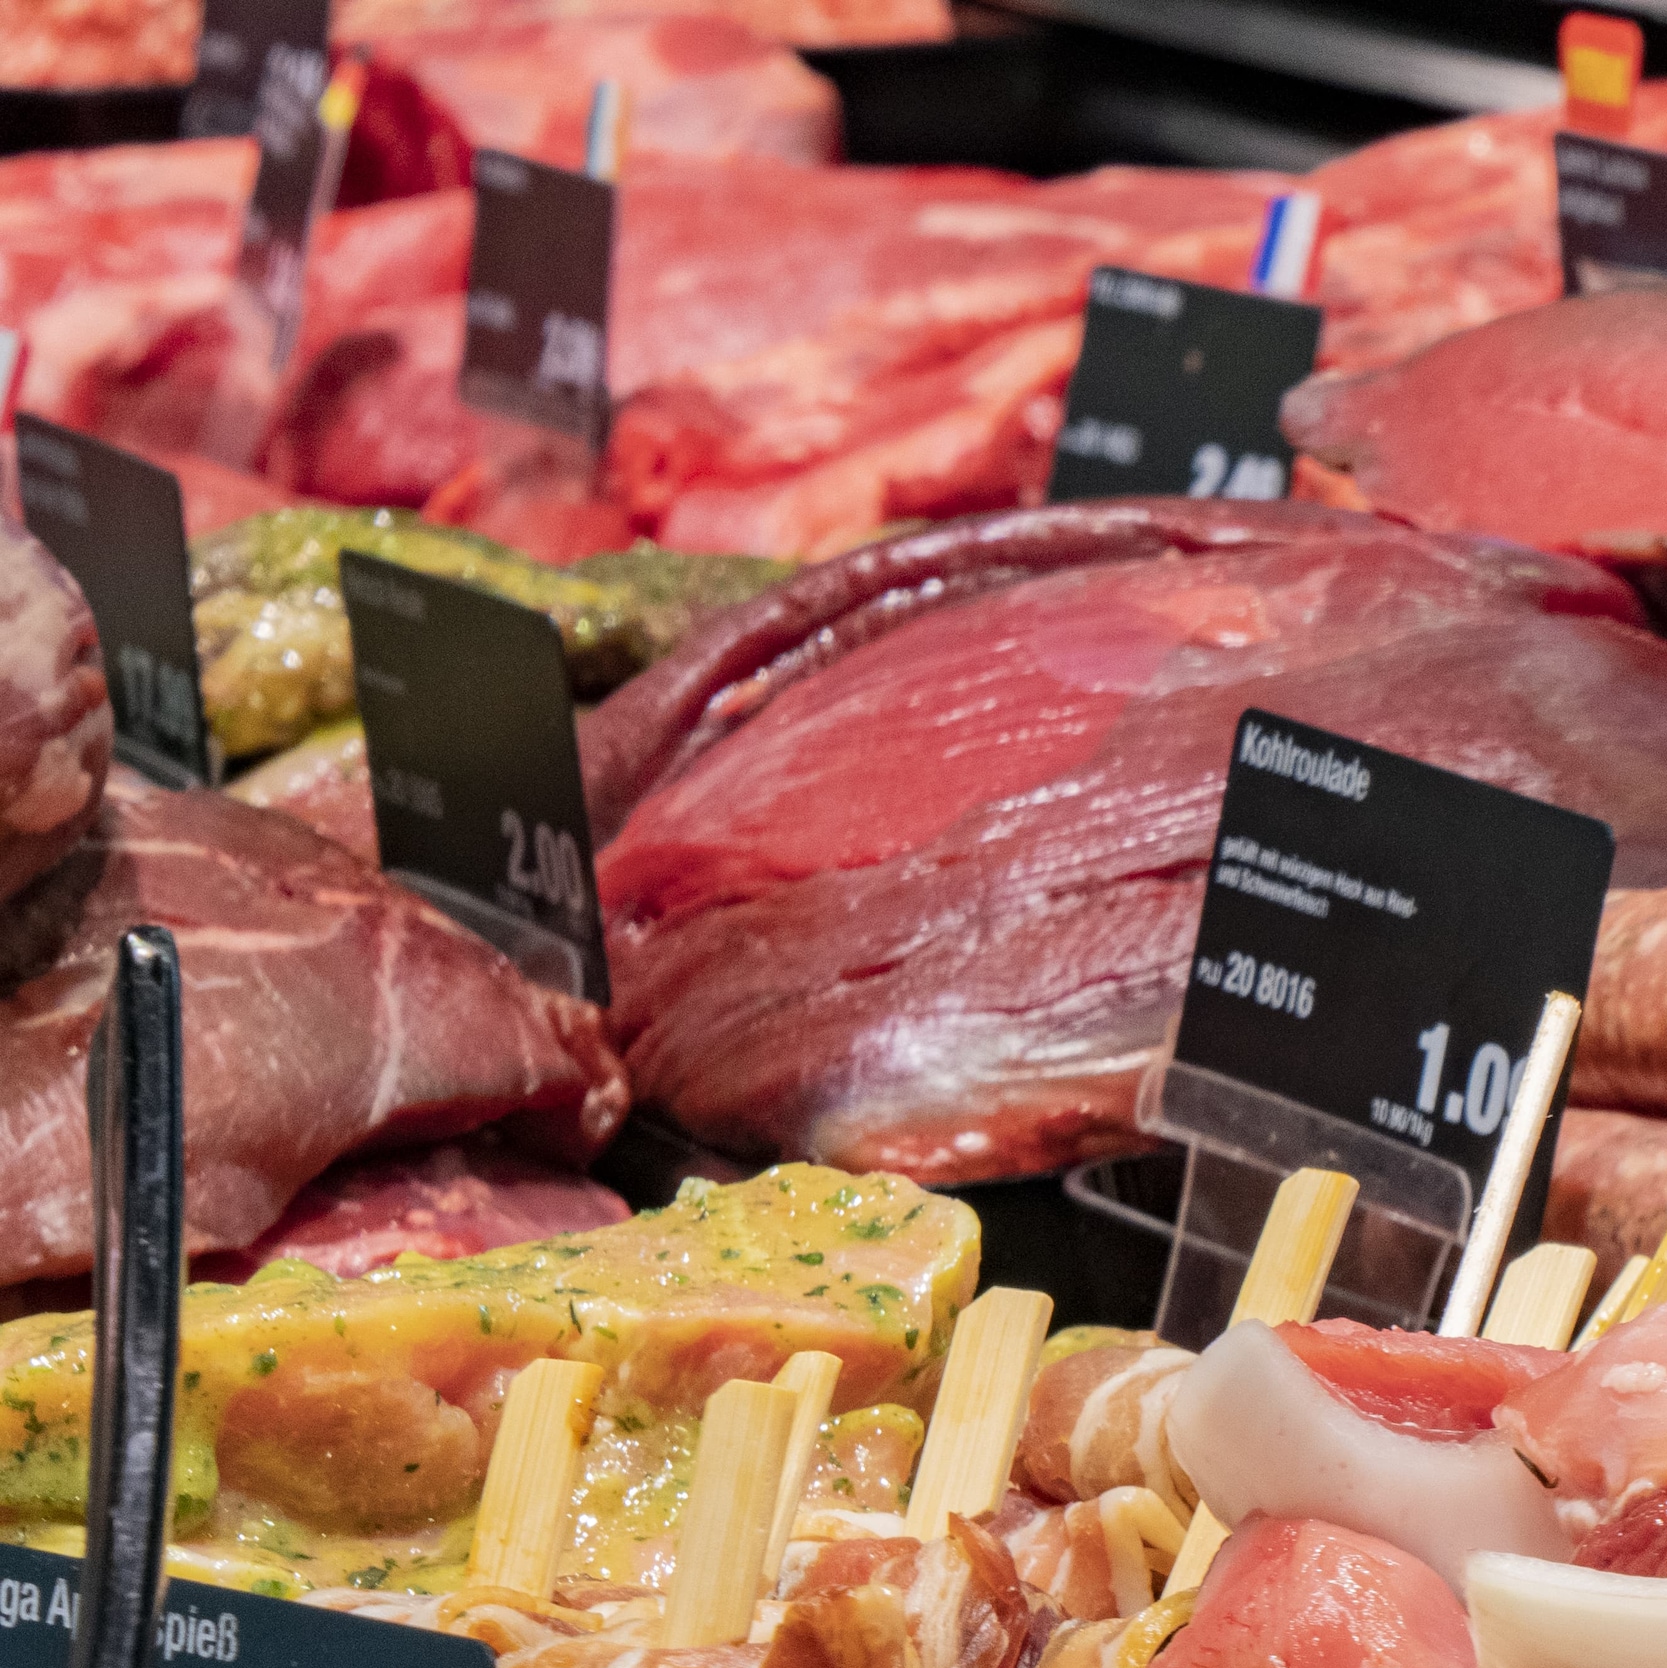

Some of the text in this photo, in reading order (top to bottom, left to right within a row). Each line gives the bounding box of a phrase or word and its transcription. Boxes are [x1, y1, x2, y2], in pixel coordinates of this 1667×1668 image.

[1239, 722, 1371, 802] Kohlroulade
[1197, 951, 1316, 1020] PLU 20 8016
